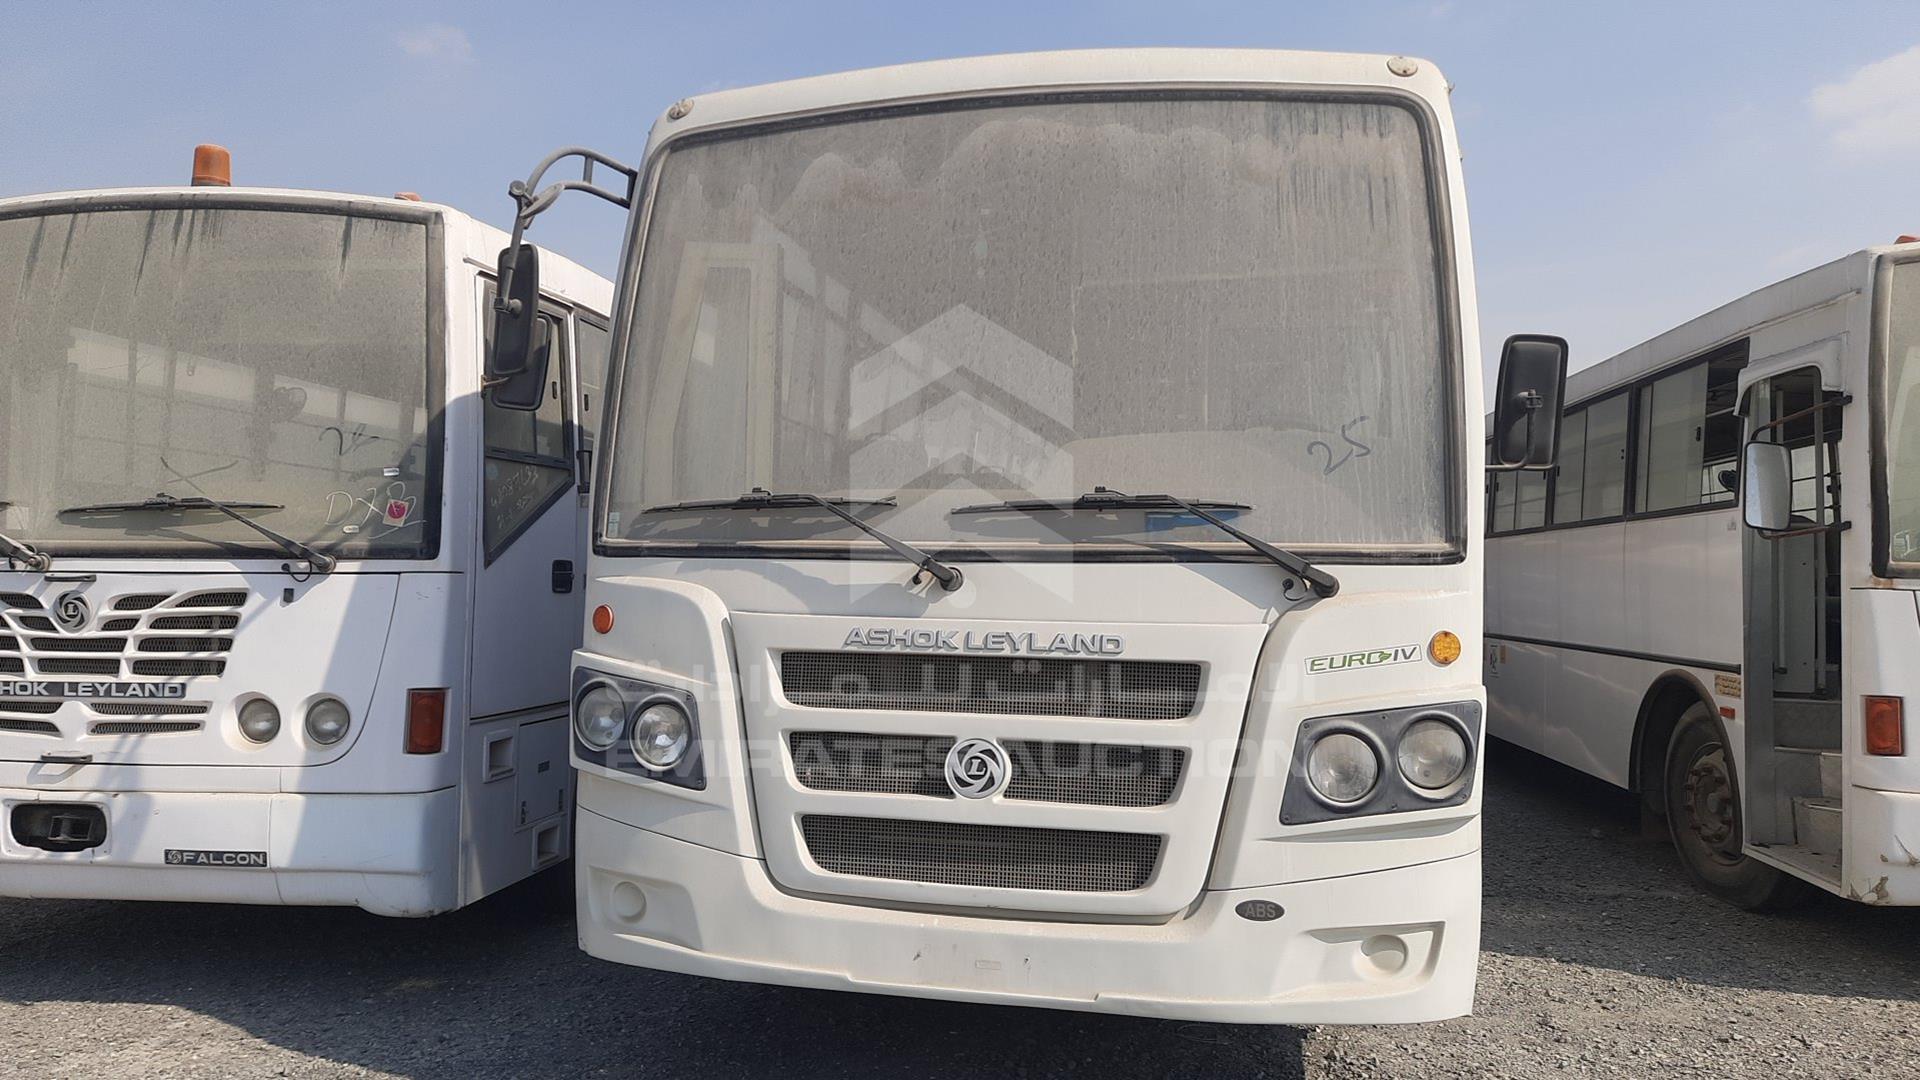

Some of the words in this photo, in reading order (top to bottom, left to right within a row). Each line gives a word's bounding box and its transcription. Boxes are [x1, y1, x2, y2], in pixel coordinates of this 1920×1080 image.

[1306, 415, 1371, 476] 25
[844, 627, 959, 650] ASHOK
[966, 630, 1125, 656] LEYLAND
[63, 682, 184, 698] LEYLAND
[182, 851, 265, 866] FALCON
[1244, 902, 1276, 918] ABS
